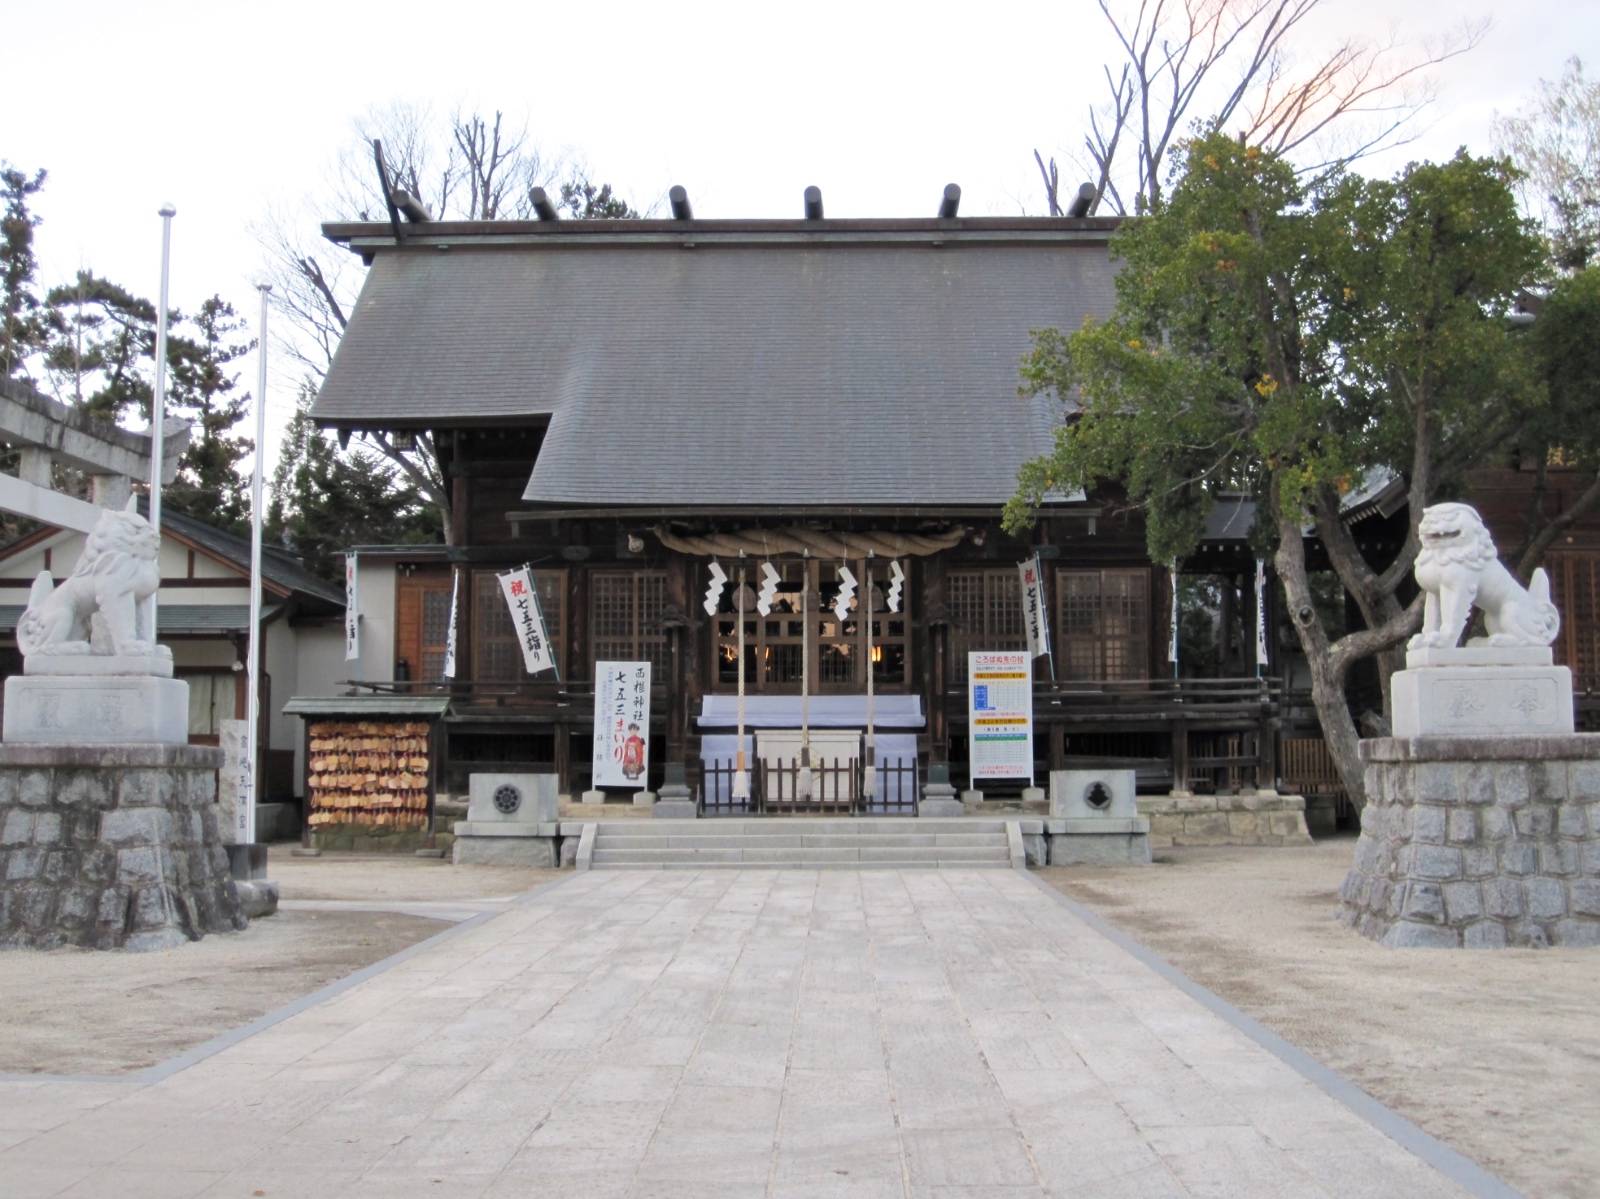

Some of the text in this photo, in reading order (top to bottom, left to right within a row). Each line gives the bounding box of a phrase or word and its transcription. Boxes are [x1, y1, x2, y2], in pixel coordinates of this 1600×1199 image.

[975, 655, 1024, 664] ころばぬ先の杖
[613, 671, 627, 765] 七五三まいり
[632, 667, 646, 722] 西根神社
